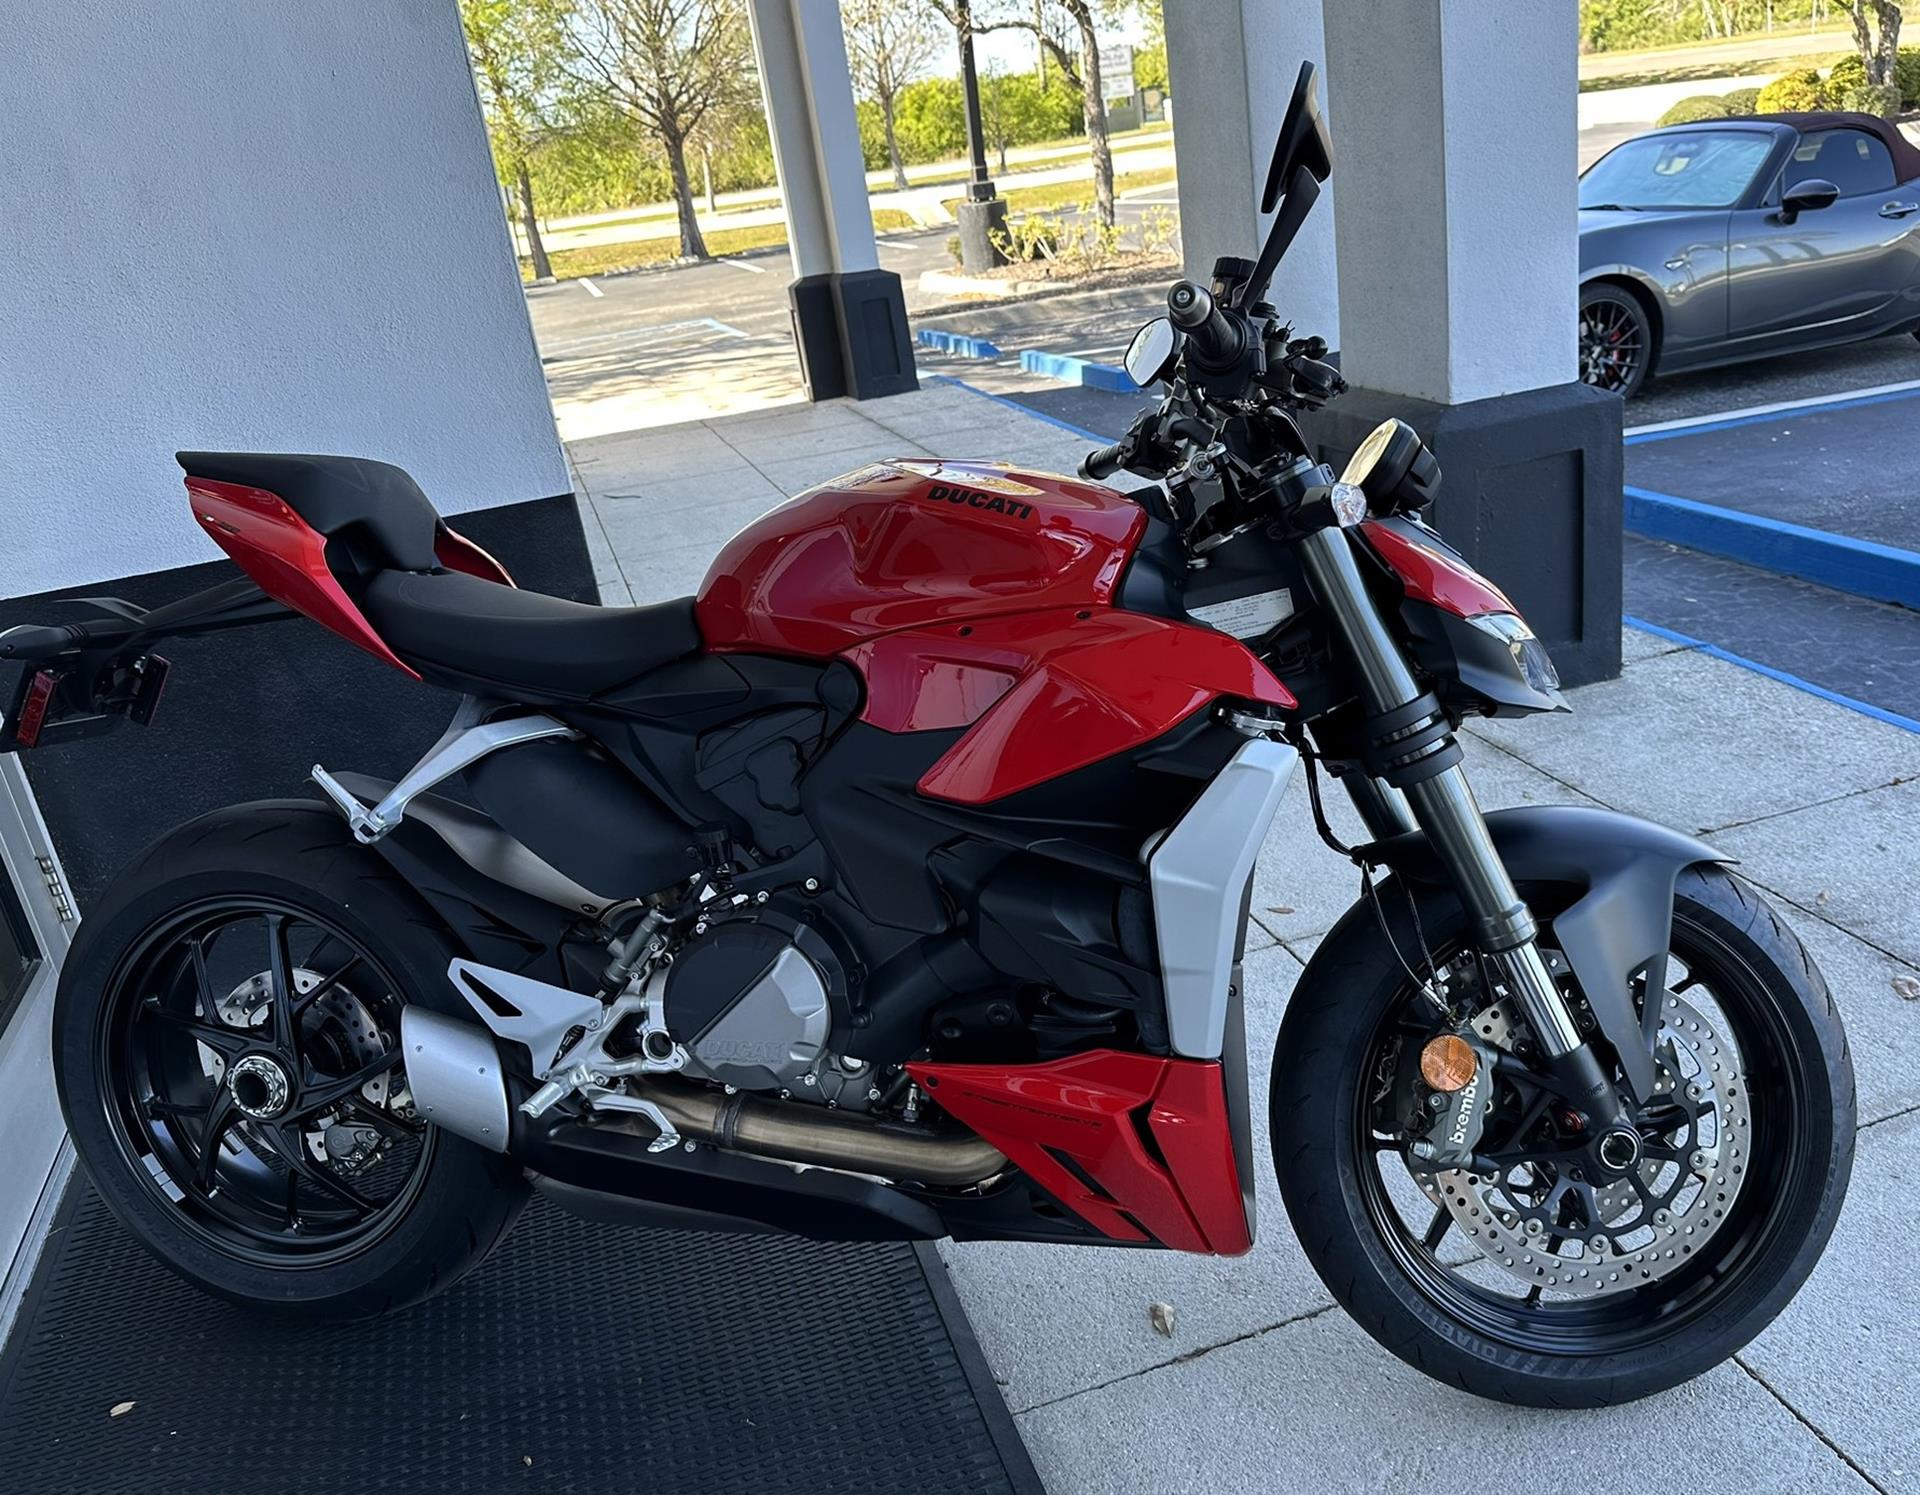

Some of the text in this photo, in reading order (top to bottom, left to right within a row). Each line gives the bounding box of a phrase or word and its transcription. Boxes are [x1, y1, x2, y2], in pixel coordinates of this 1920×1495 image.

[927, 486, 1033, 520] DUCATI
[703, 1040, 786, 1060] DUCATI
[1448, 1075, 1480, 1145] brembo
